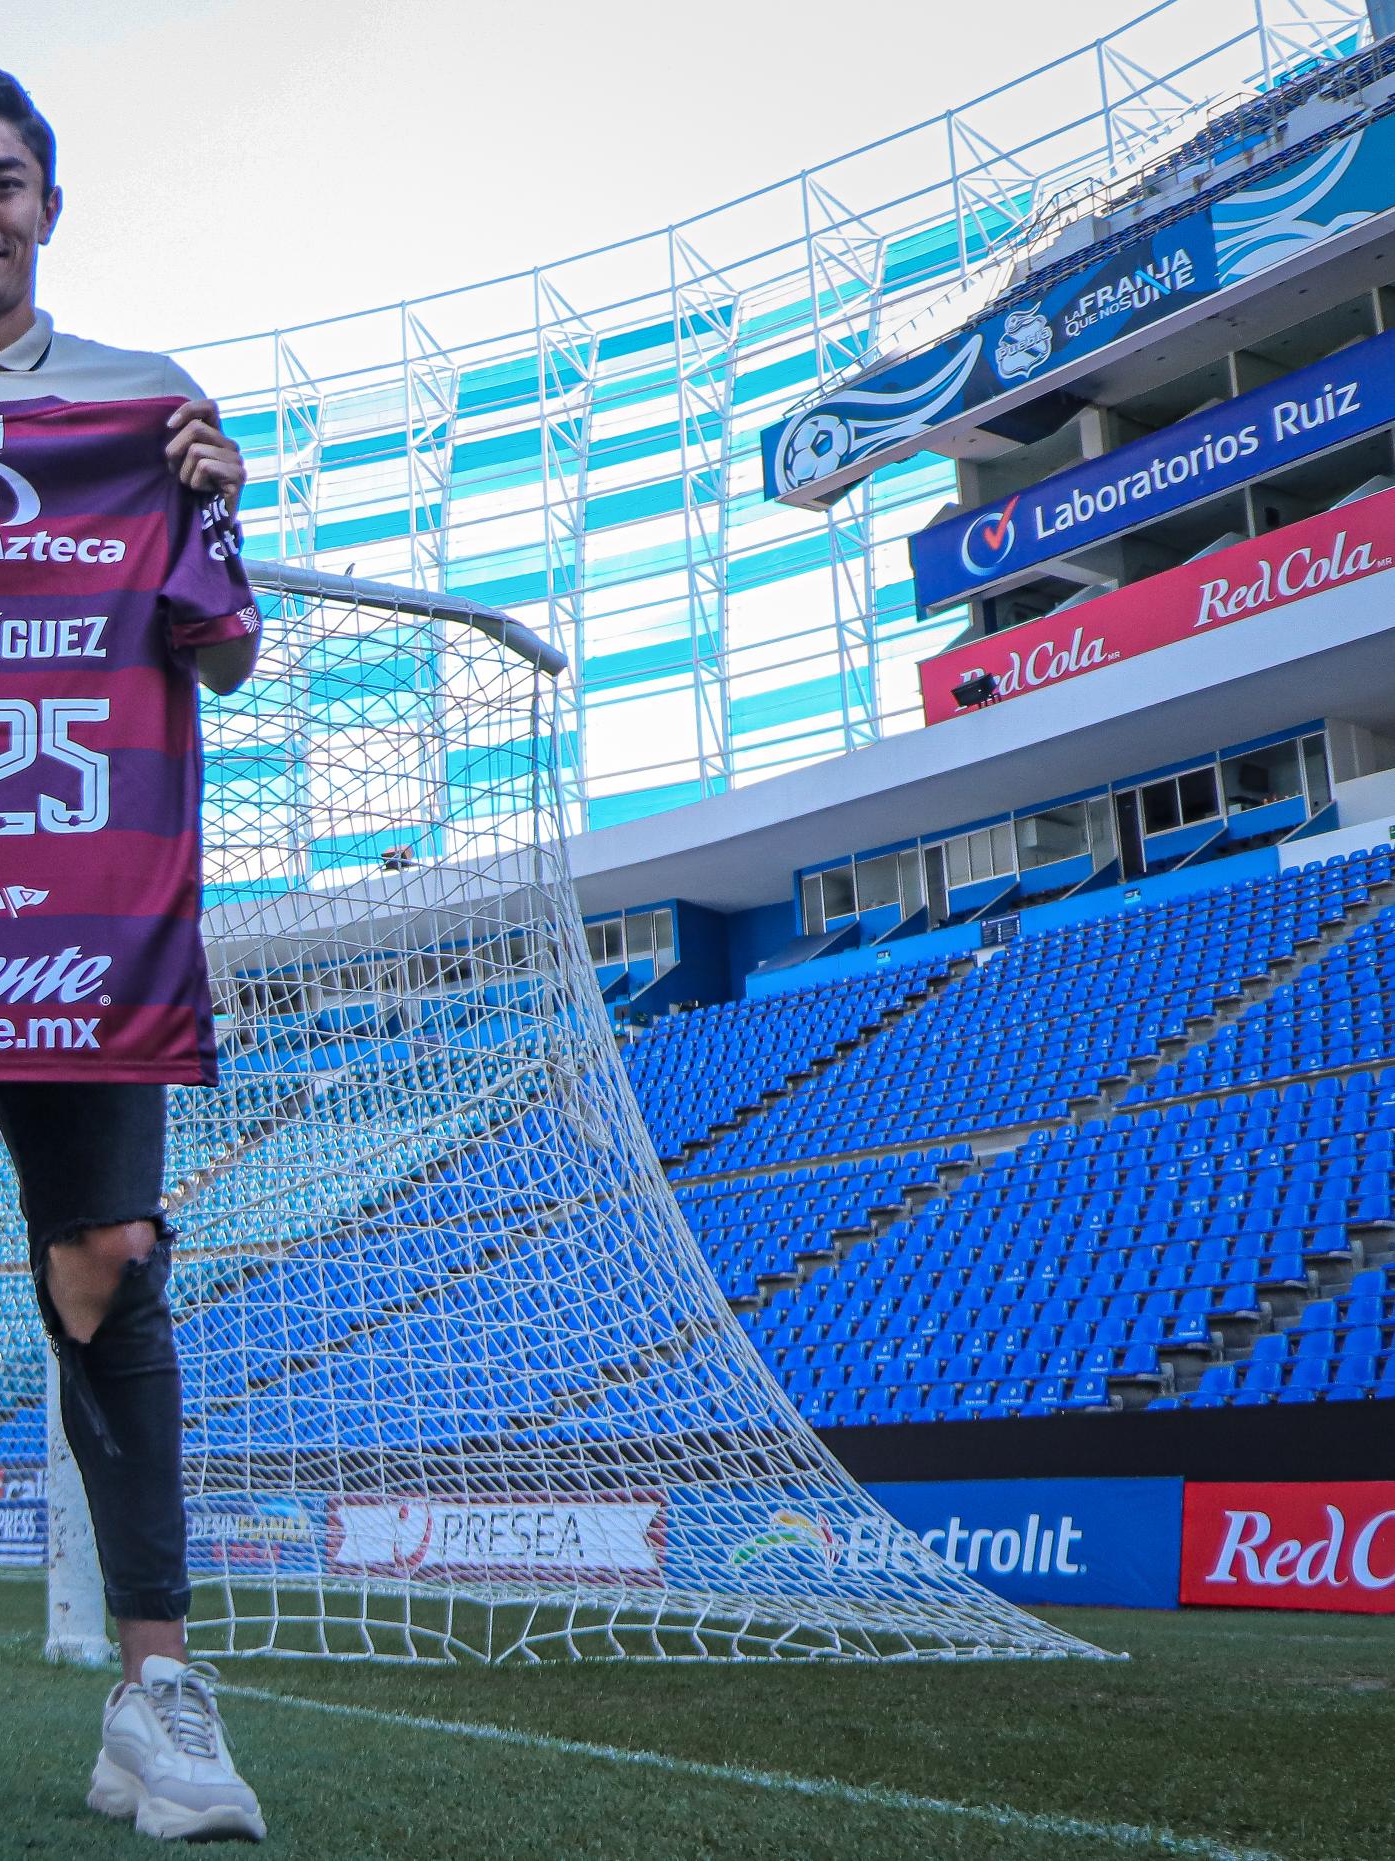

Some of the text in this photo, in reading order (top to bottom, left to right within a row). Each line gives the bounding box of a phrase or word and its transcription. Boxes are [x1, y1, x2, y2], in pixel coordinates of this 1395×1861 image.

[1078, 248, 1193, 317] FRANJA
[1065, 313, 1099, 337] QUE
[1035, 381, 1362, 540] Laboratorios Ruiz
[443, 1512, 585, 1559] PRESEA
